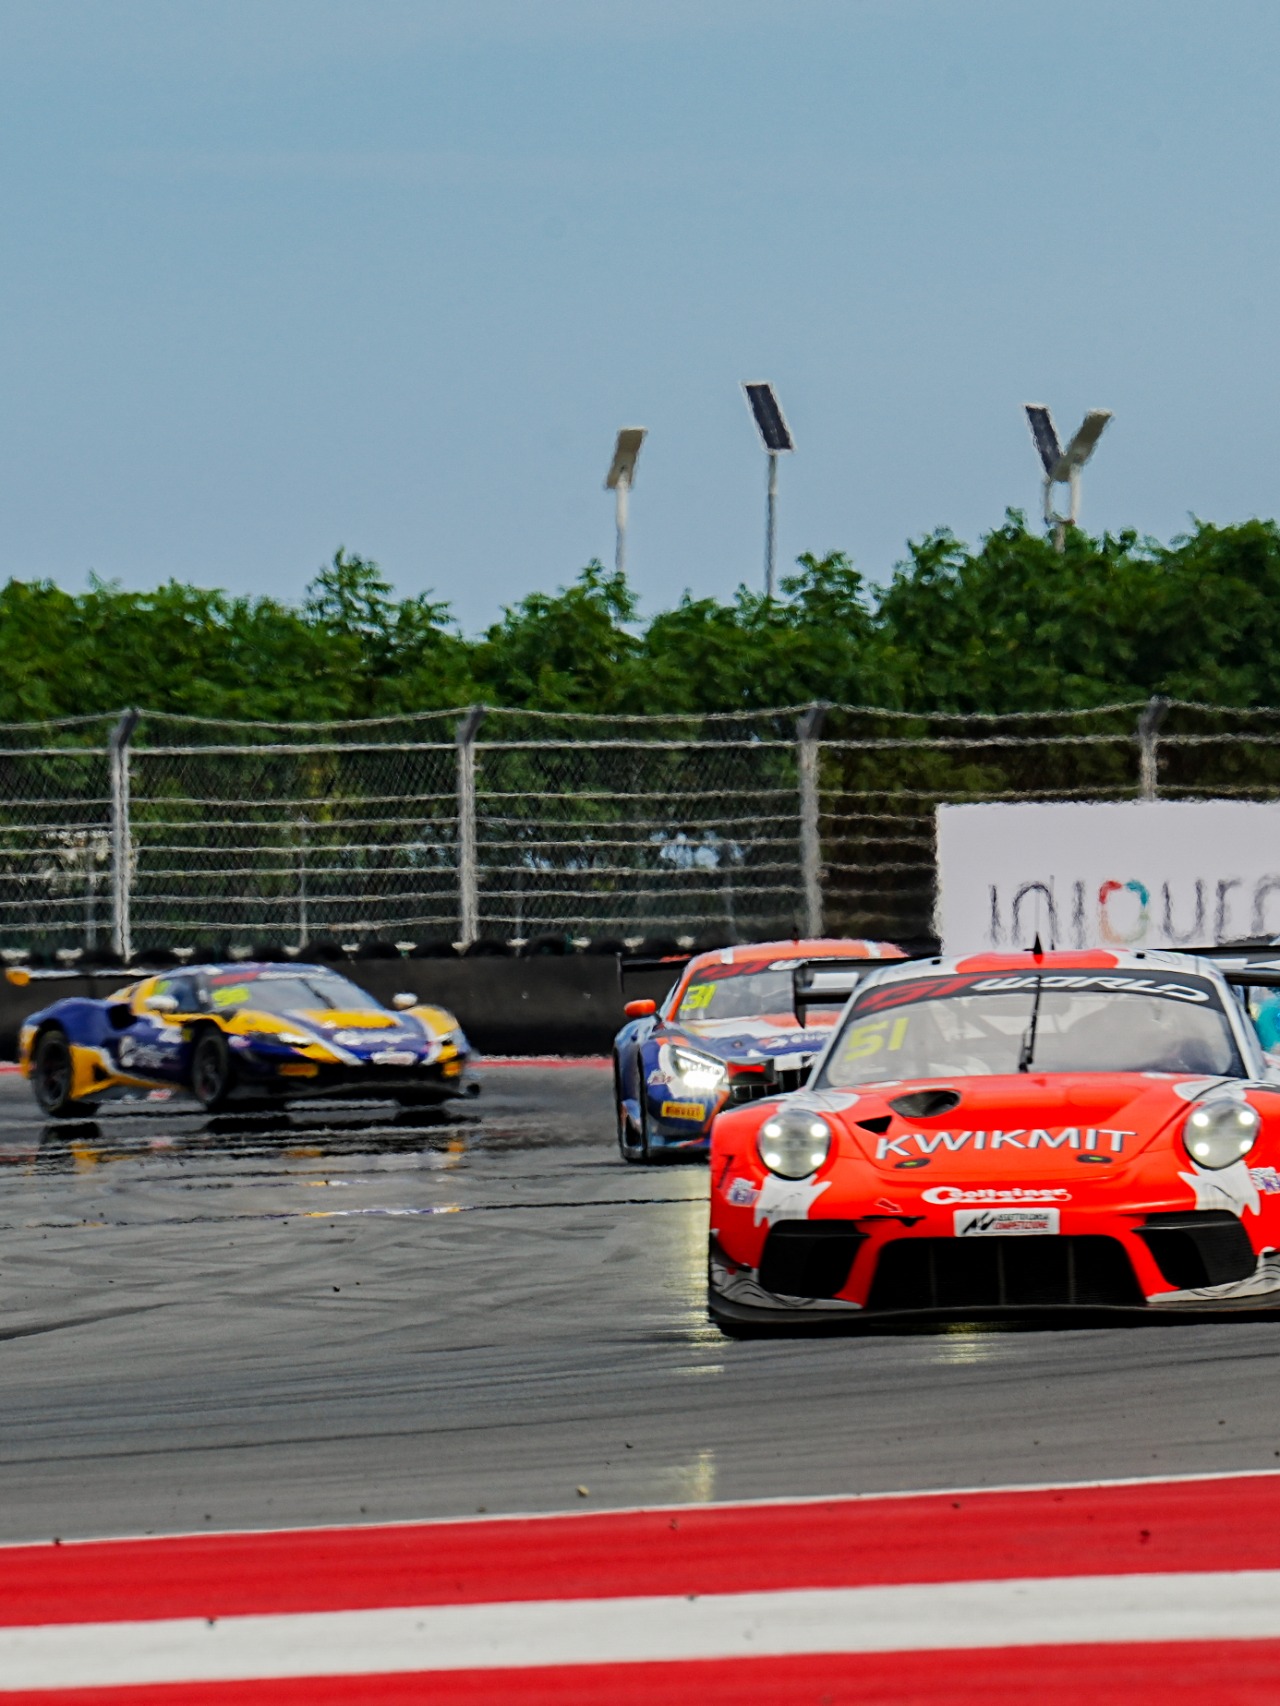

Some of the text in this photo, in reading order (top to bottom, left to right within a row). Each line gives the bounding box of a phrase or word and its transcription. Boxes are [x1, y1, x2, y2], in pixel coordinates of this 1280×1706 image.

[854, 973, 1210, 1011] GT WORLD
[844, 1017, 909, 1062] 51
[875, 1127, 1137, 1160] KWIKMIT
